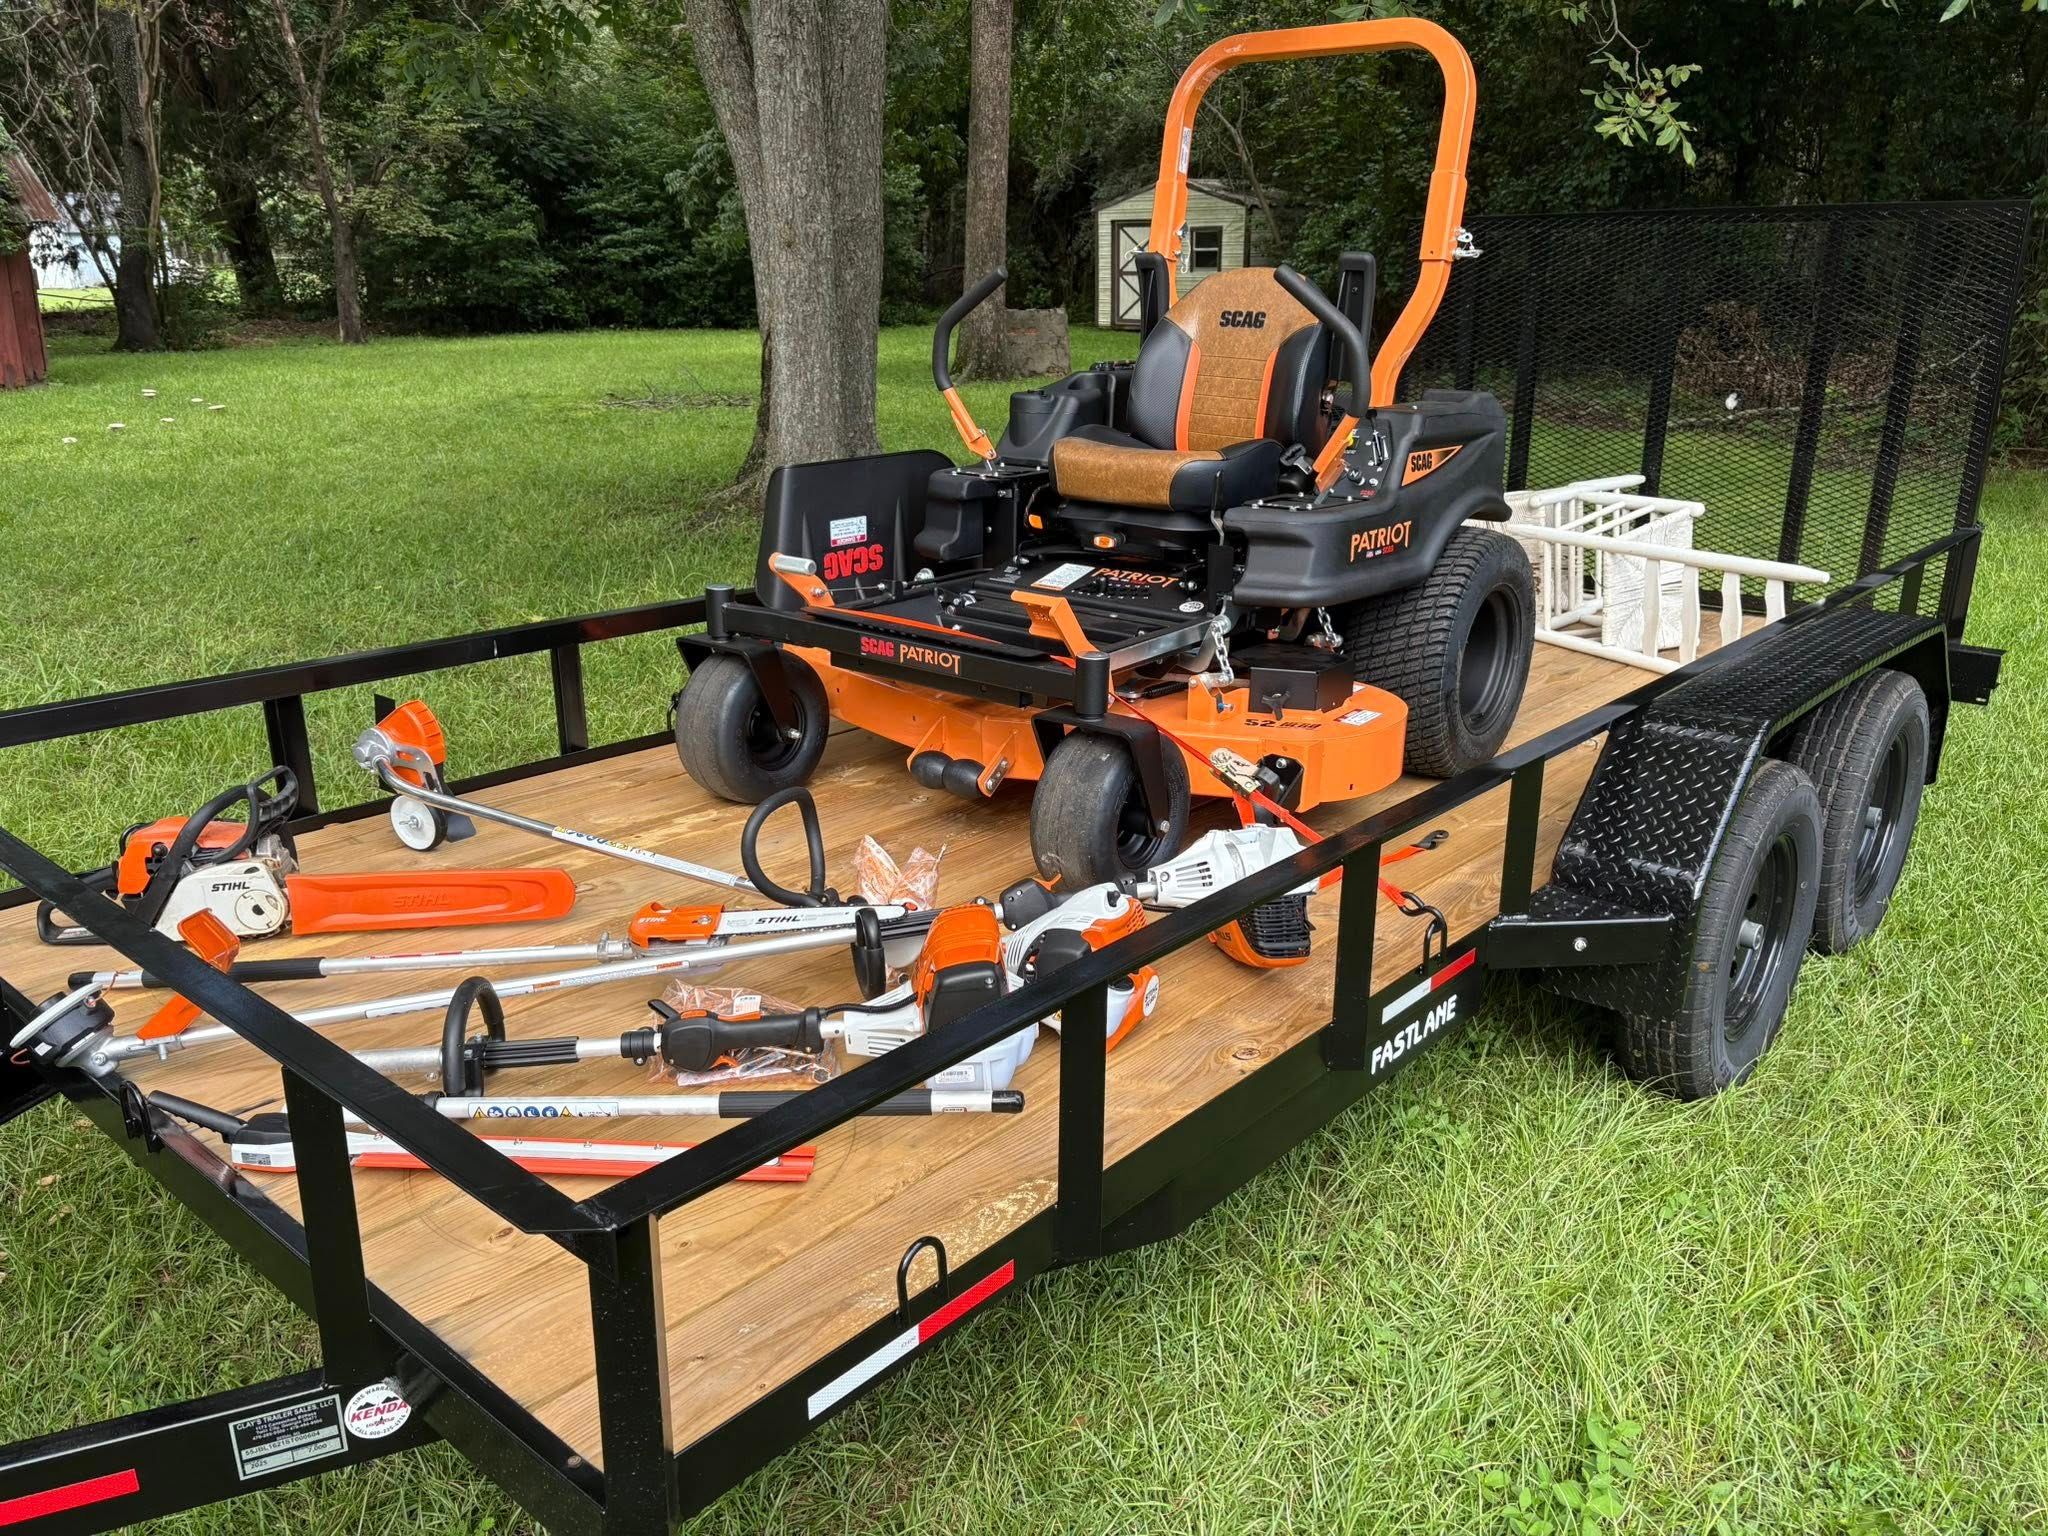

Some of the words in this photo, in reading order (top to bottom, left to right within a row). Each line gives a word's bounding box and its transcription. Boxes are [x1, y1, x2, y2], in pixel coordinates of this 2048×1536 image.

[1219, 310, 1267, 328] SCAG
[1411, 452, 1433, 472] SCAG
[1349, 519, 1412, 563] PATRIOT
[823, 543, 884, 581] SCAG
[1092, 567, 1179, 588] PATRIOT
[860, 636, 896, 657] SCAG
[899, 643, 961, 675] PATRIOT
[1244, 718, 1276, 728] 52
[211, 881, 251, 892] STIHL
[393, 894, 450, 909] STIHL
[638, 916, 668, 924] STIHL
[754, 914, 801, 925] STIHL
[1371, 994, 1458, 1075] FASTLANE
[235, 1417, 262, 1431] CLAY'S
[262, 1409, 293, 1423] TRAILER
[319, 1399, 334, 1408] LLC
[350, 1400, 408, 1423] KENDA
